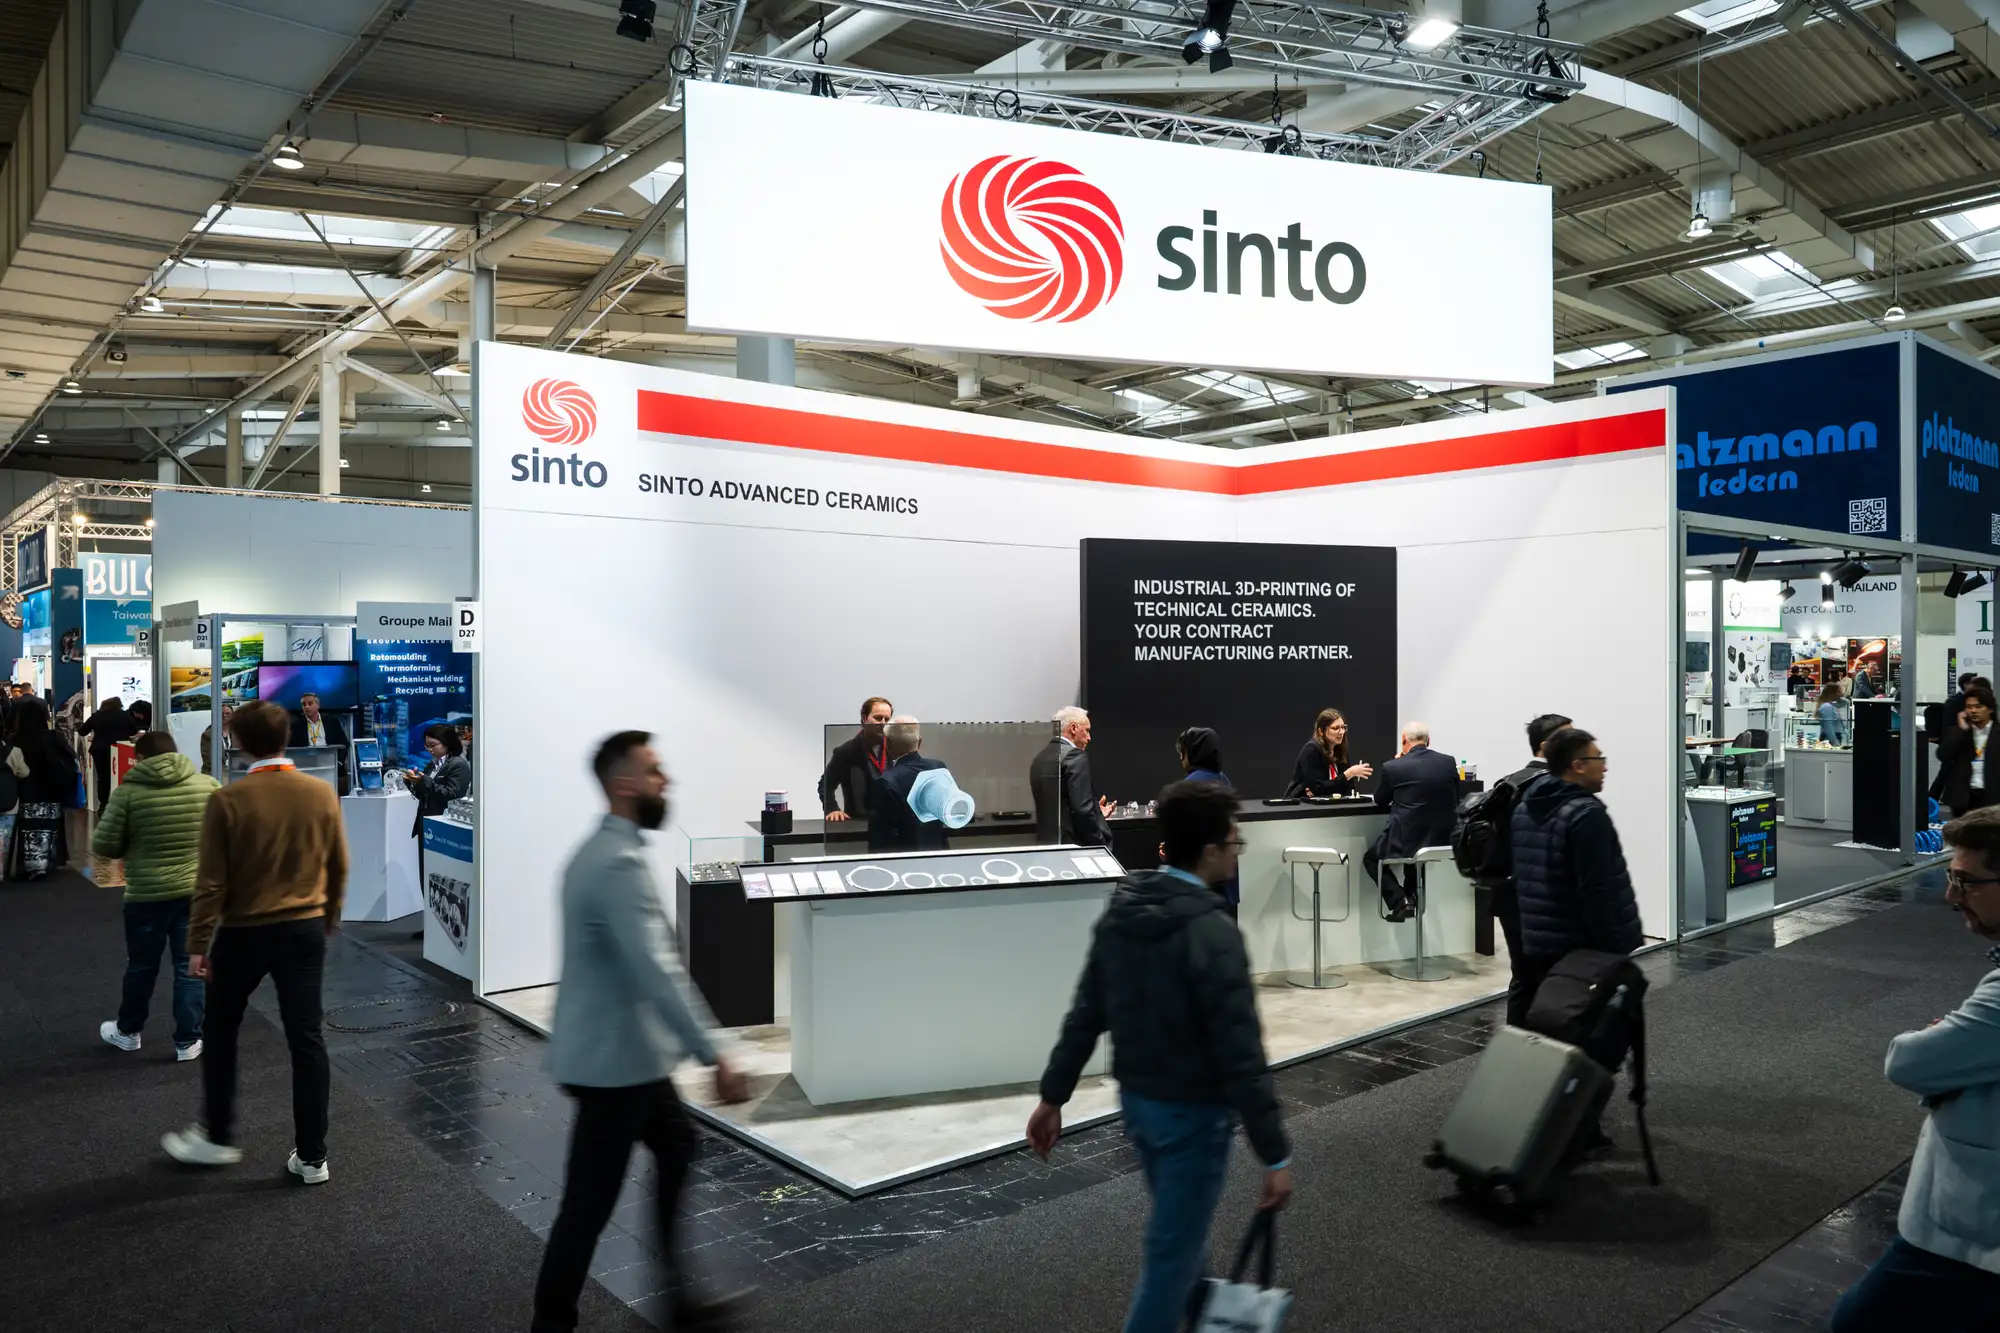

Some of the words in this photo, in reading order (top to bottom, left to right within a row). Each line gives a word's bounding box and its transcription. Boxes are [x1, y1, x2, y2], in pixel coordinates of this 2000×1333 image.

[1157, 209, 1366, 304] sinto
[1677, 421, 1878, 469] atzmann
[1922, 411, 1999, 469] platzmann
[511, 447, 608, 488] sinto
[1699, 469, 1798, 497] federn
[638, 474, 704, 497] SINTO
[709, 480, 820, 507] ADVANCED
[825, 491, 919, 515] CERAMICS
[1134, 580, 1231, 596] INDUSTRIAL
[1235, 581, 1332, 597] 3D-PRINTING
[1335, 582, 1356, 597] OF
[112, 611, 152, 620] Taiwan
[1134, 602, 1227, 617] TECHNICAL
[1231, 603, 1316, 618] CERAMICS.
[1834, 605, 1857, 614] LTD.
[379, 615, 425, 628] Groupe
[428, 616, 452, 627] Mail
[461, 609, 475, 626] D
[197, 623, 208, 634] D
[459, 629, 476, 638] D27
[1134, 624, 1181, 639] YOUR
[1185, 624, 1273, 639] CONTRACT
[140, 632, 149, 641] D
[370, 653, 427, 662] Rotomoulding
[1134, 645, 1274, 661] MANUFACTURING
[1278, 645, 1353, 660] PARTNER.
[379, 664, 441, 673] Thermoforming
[387, 675, 431, 683] Mechanical
[433, 675, 464, 684] welding
[395, 686, 434, 695] Recycling
